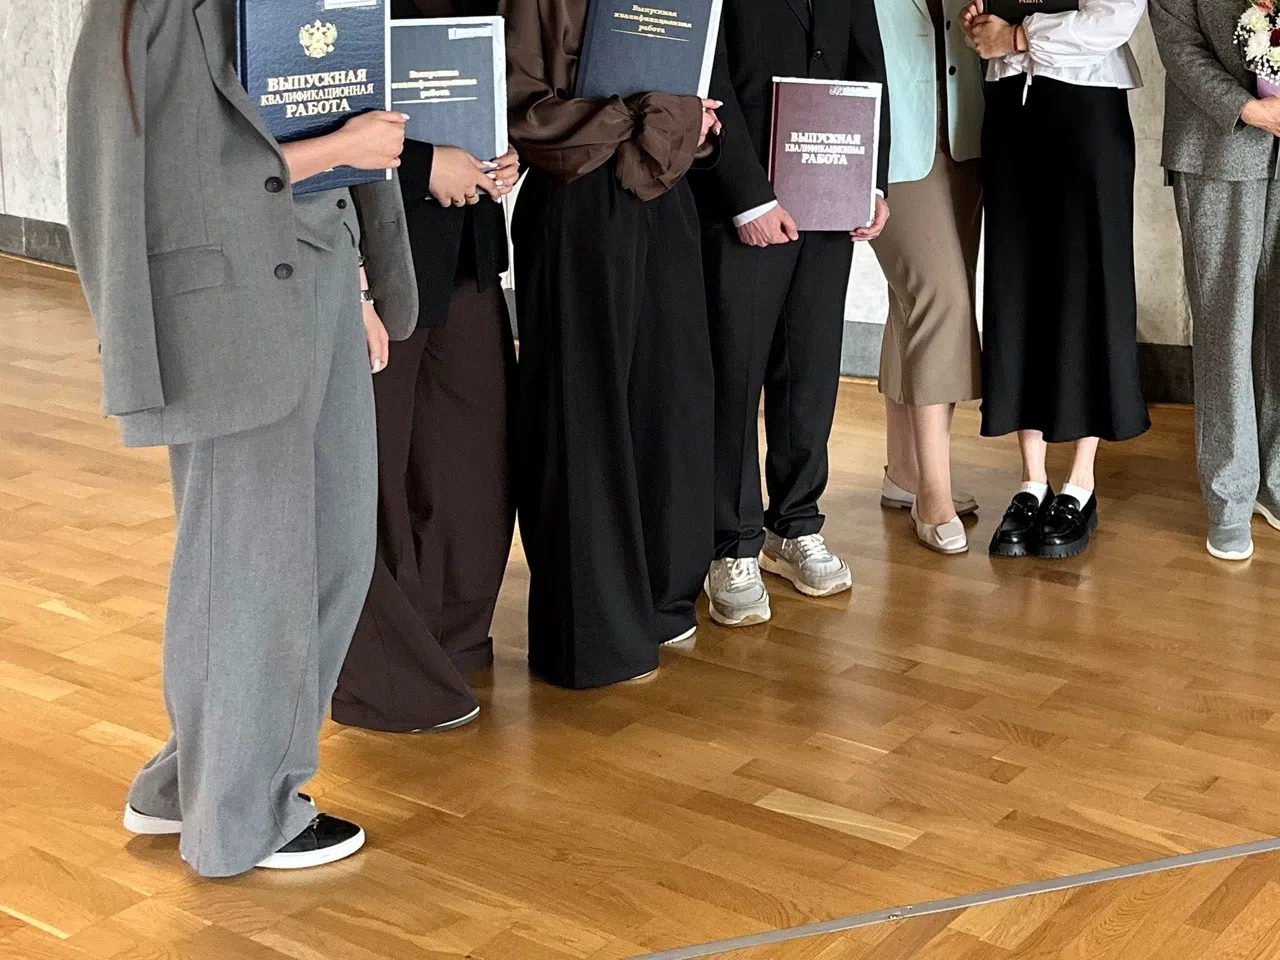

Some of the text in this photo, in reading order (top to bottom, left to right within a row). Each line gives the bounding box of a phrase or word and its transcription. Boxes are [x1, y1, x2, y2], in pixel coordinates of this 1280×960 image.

[267, 69, 368, 92] ВЫПУСКНАЯ
[260, 83, 375, 106] КВАЛИФИКАЦИОННАЯ
[286, 98, 351, 118] РАБОТА
[791, 132, 861, 145] ВЫПУСКНАЯ
[801, 153, 848, 165] РАБОТА
